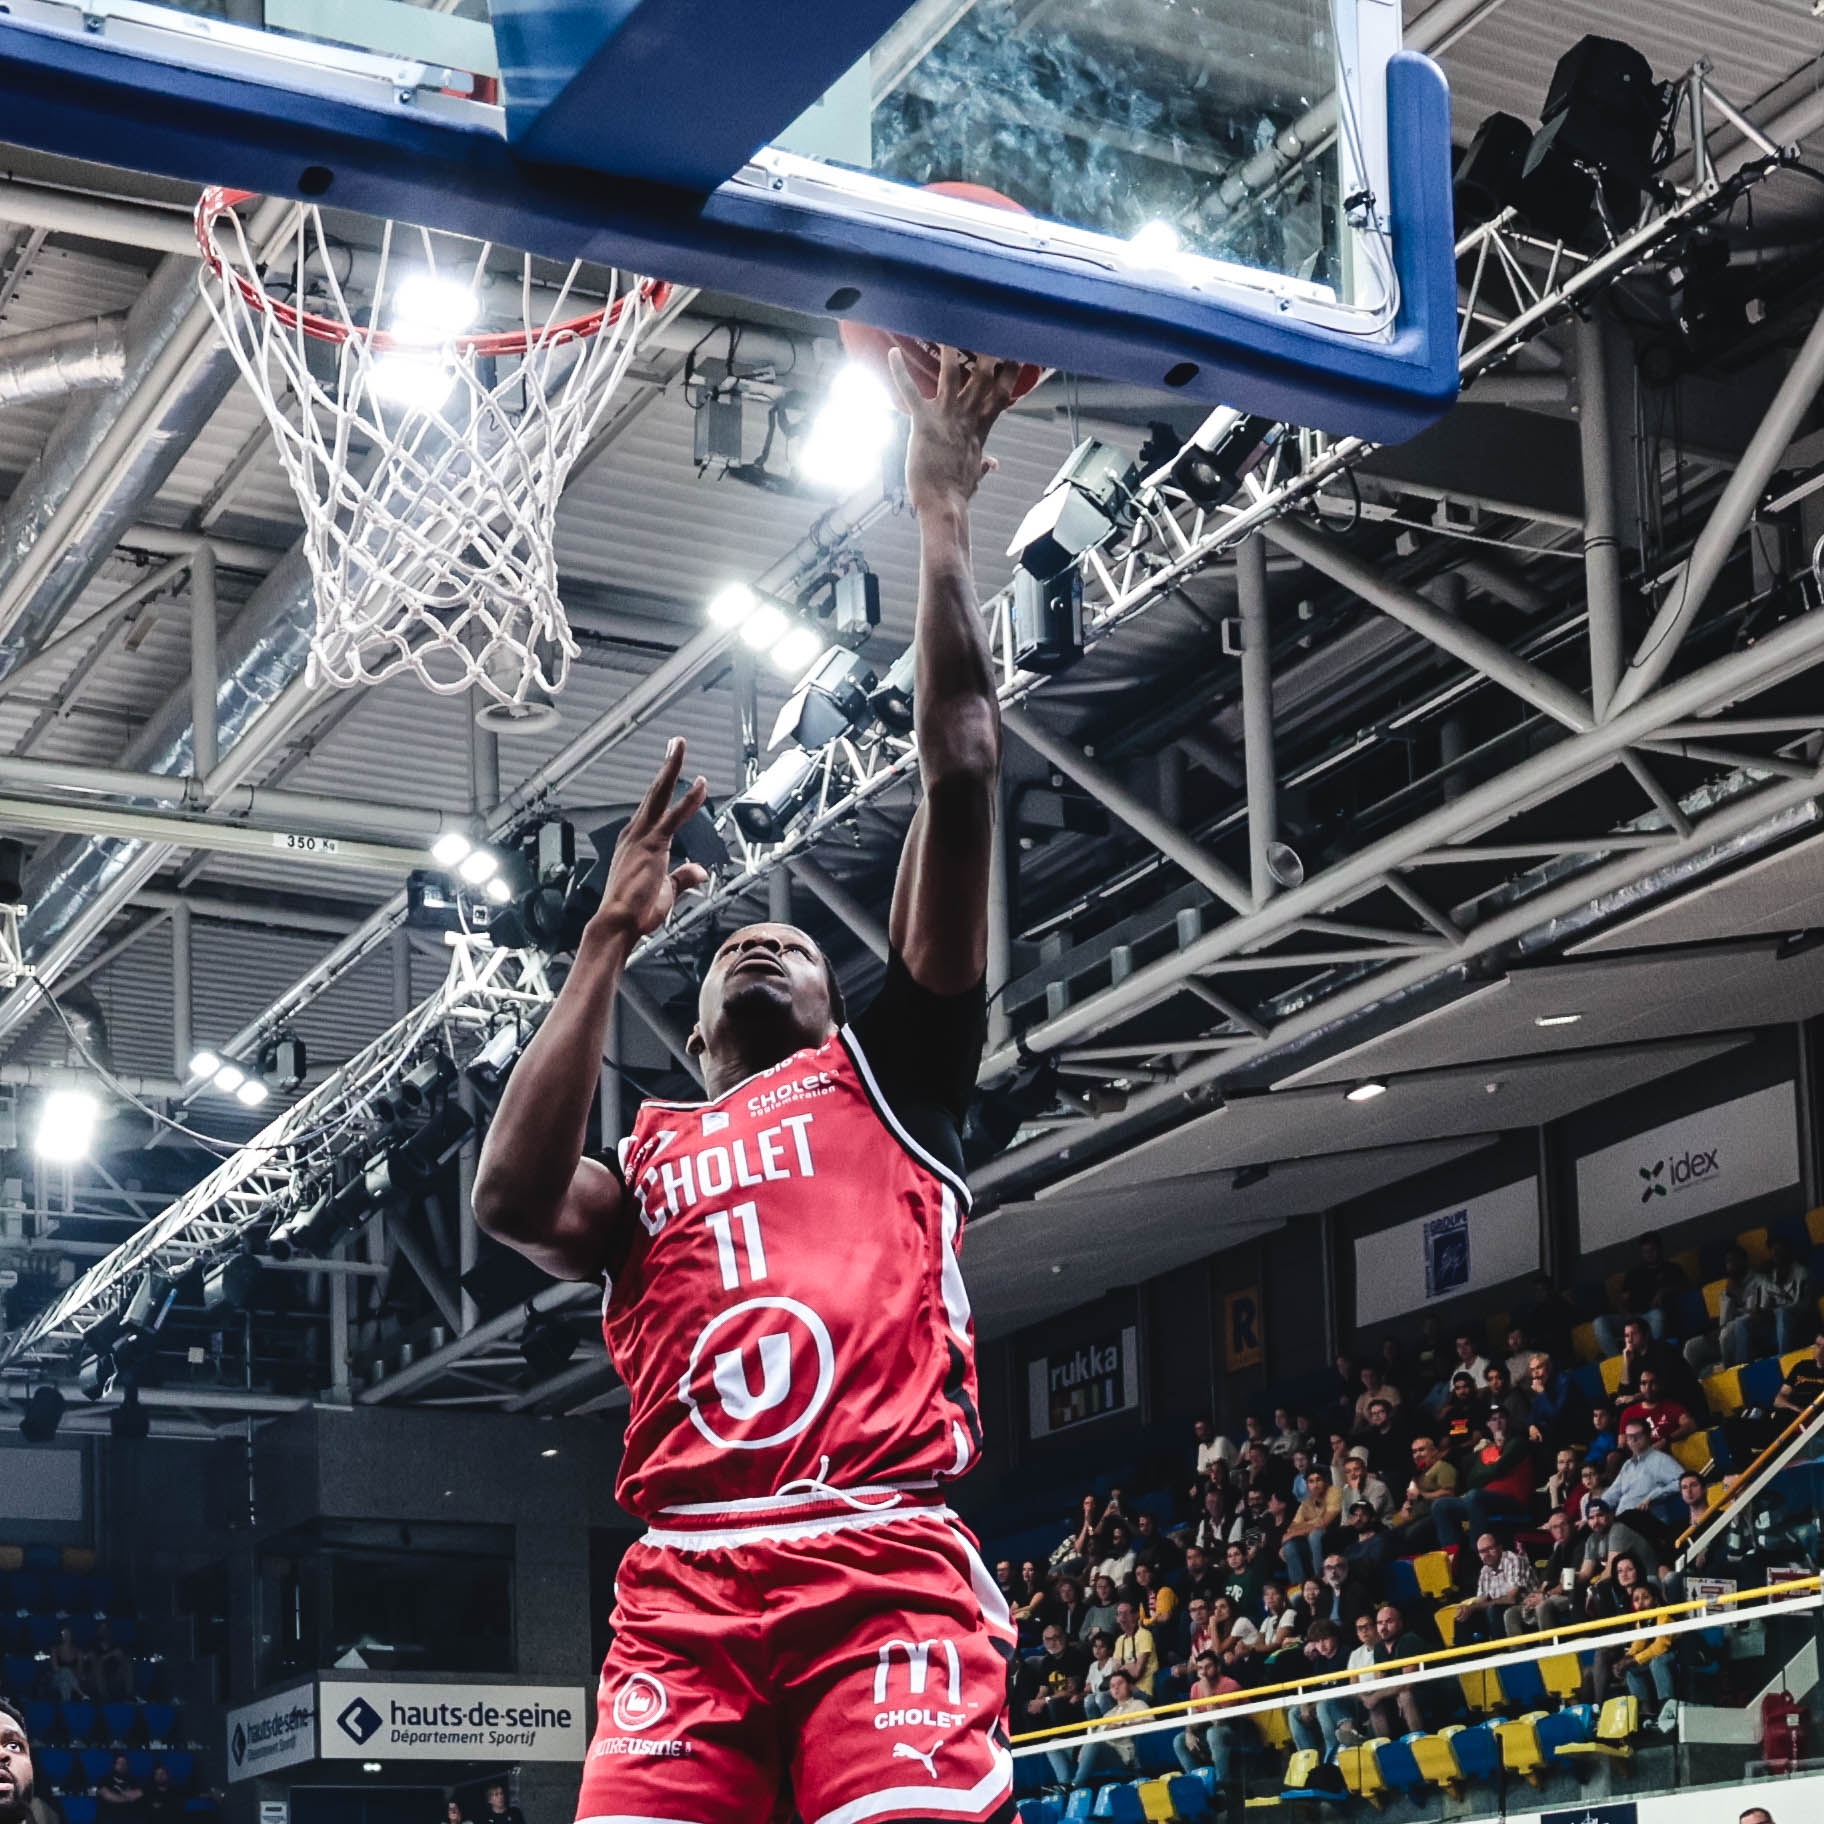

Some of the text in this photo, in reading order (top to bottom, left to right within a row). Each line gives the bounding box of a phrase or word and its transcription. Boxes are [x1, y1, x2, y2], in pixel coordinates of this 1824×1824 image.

[634, 1113, 816, 1236] CHOLET
[1669, 1148, 1720, 1187] idex
[706, 1201, 768, 1290] 11
[1232, 1296, 1259, 1353] R
[1051, 1344, 1118, 1392] rukka
[391, 1730, 536, 1747] Département Sportif
[874, 1708, 966, 1730] CHOLET
